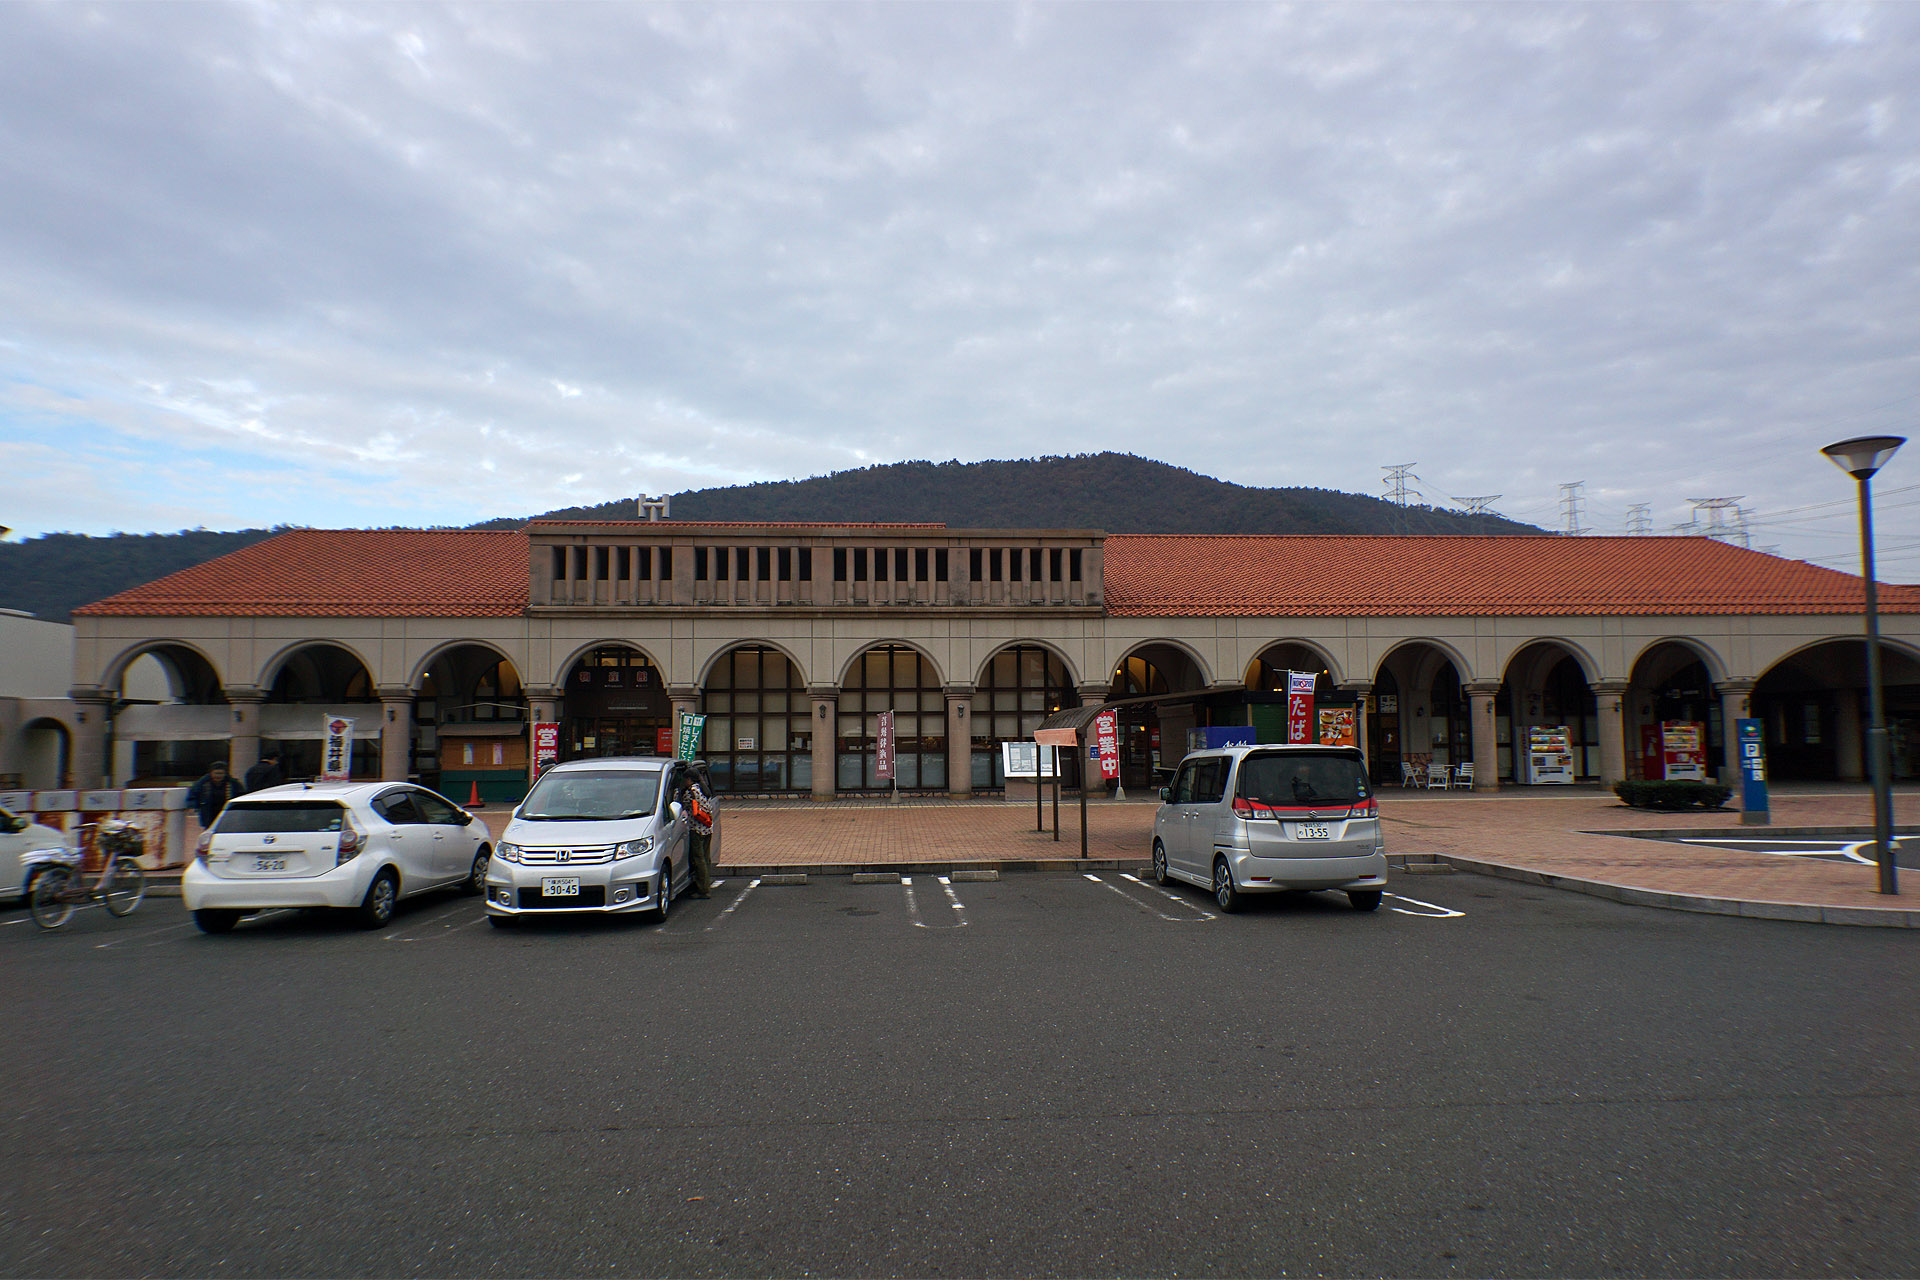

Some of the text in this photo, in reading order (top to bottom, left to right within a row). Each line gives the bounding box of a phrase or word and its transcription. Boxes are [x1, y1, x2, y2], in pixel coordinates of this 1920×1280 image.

[1096, 715, 1117, 776] 営業中
[1747, 745, 1757, 756] P
[1304, 828, 1329, 837] 13-55
[550, 884, 578, 895] 90-45
